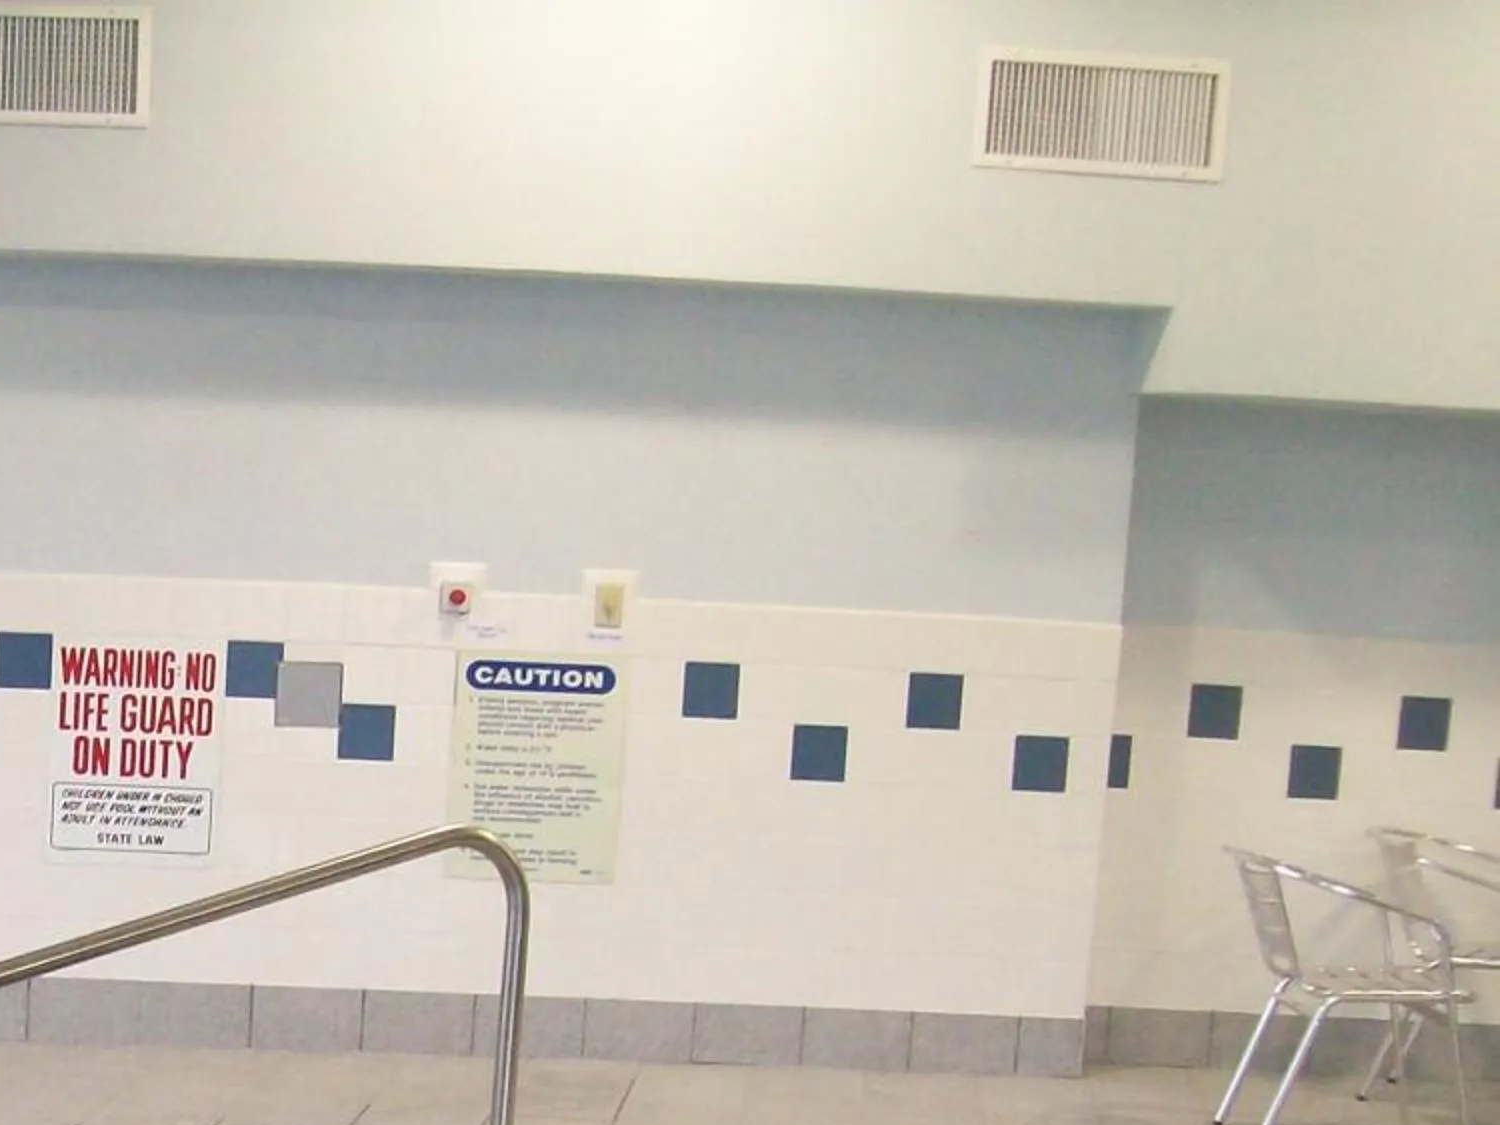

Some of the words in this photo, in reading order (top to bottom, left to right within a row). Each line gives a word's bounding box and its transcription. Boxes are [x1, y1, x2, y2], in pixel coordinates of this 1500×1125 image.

[185, 652, 216, 692] NO
[474, 666, 605, 688] CAUTION
[59, 691, 110, 732] LIFE
[120, 694, 213, 736] GUARD
[73, 735, 111, 776] ON
[119, 738, 194, 779] DUTY
[97, 832, 132, 845] STATE
[138, 834, 165, 846] LAW
